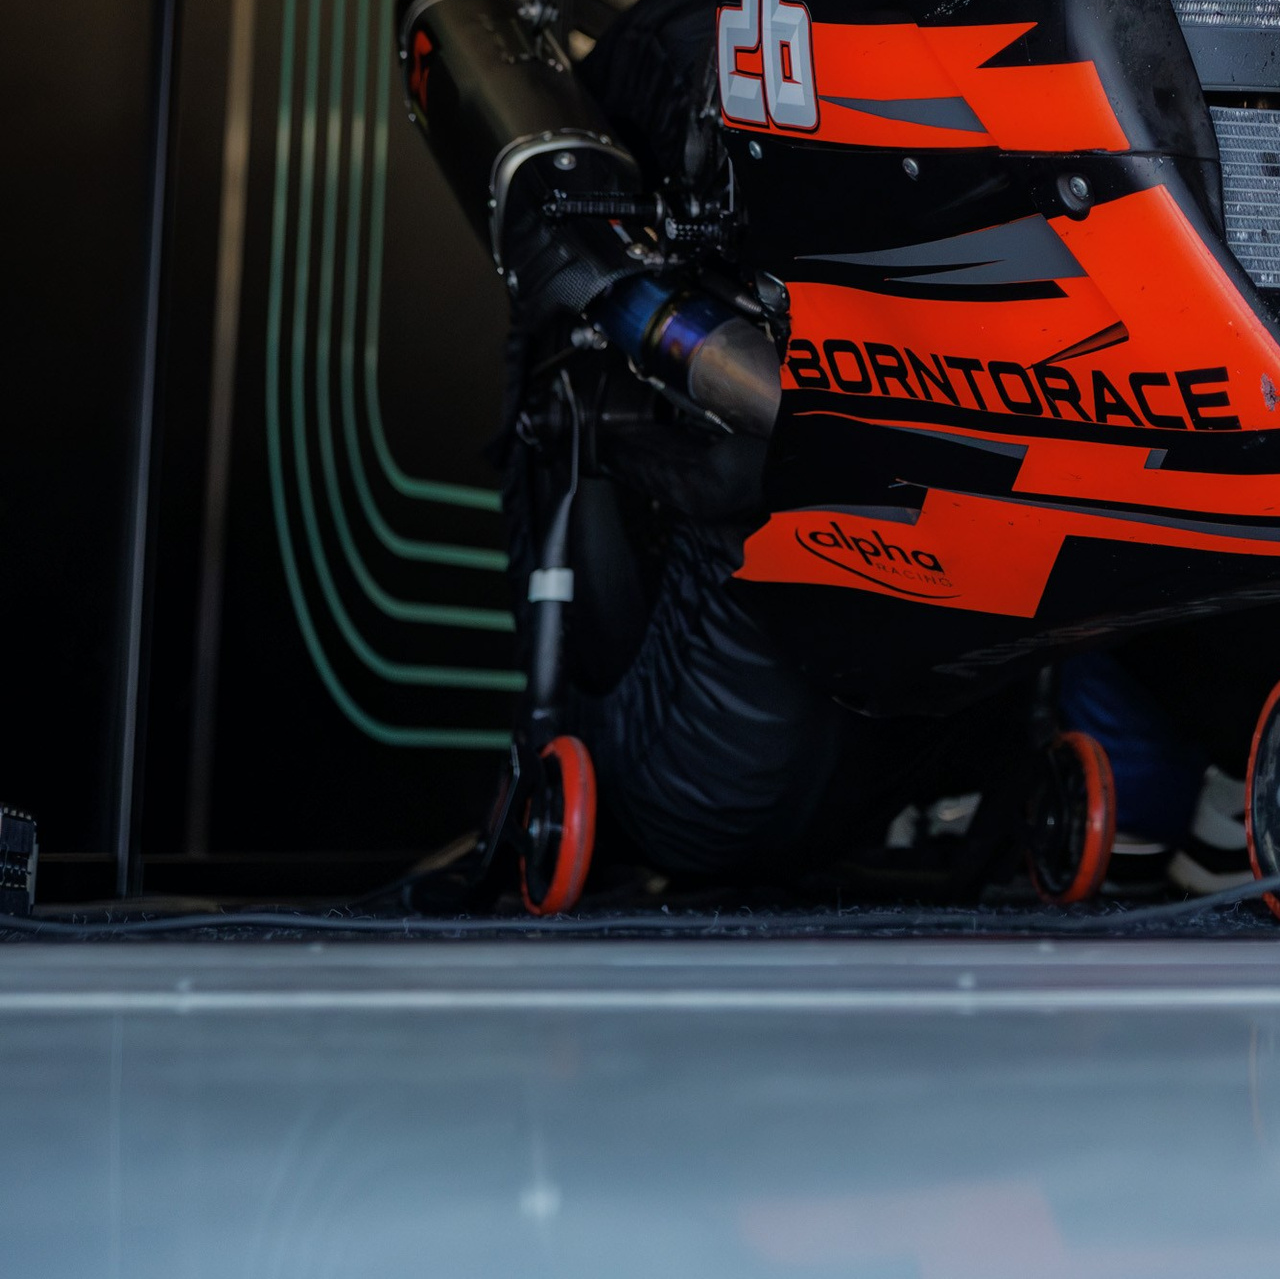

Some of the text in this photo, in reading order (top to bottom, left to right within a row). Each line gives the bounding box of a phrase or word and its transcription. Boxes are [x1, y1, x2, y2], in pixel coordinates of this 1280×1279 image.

[787, 337, 1242, 431] BORNTORACE
[809, 521, 945, 574] alpha
[876, 561, 955, 589] RACING
